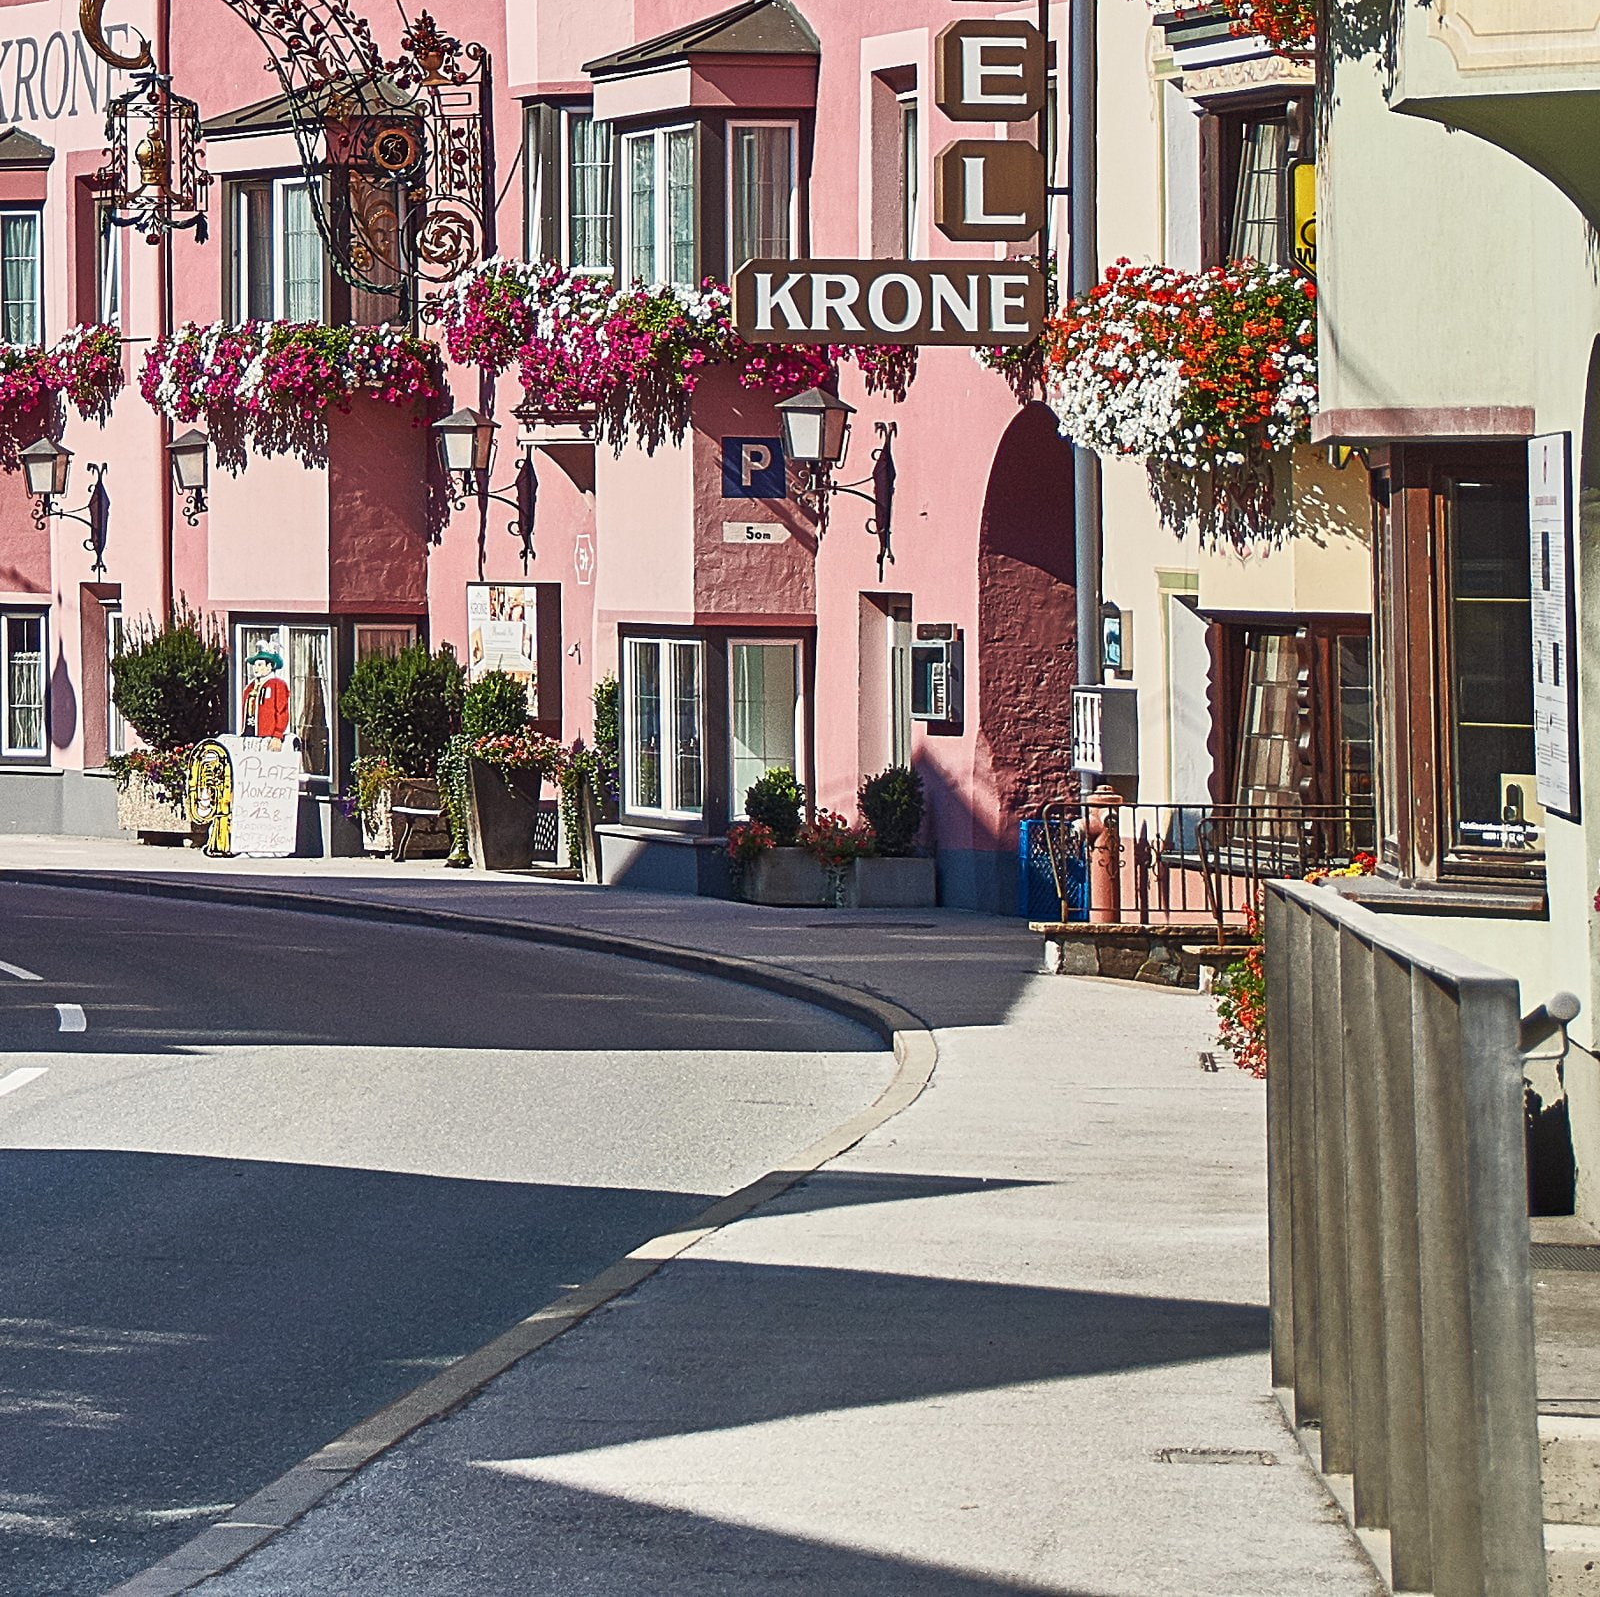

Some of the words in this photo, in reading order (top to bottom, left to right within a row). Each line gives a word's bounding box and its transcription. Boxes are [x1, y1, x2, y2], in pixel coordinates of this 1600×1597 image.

[753, 270, 1036, 335] KRONE
[741, 443, 772, 487] P
[239, 755, 298, 781] PLATZ
[238, 781, 297, 800] KONZERT
